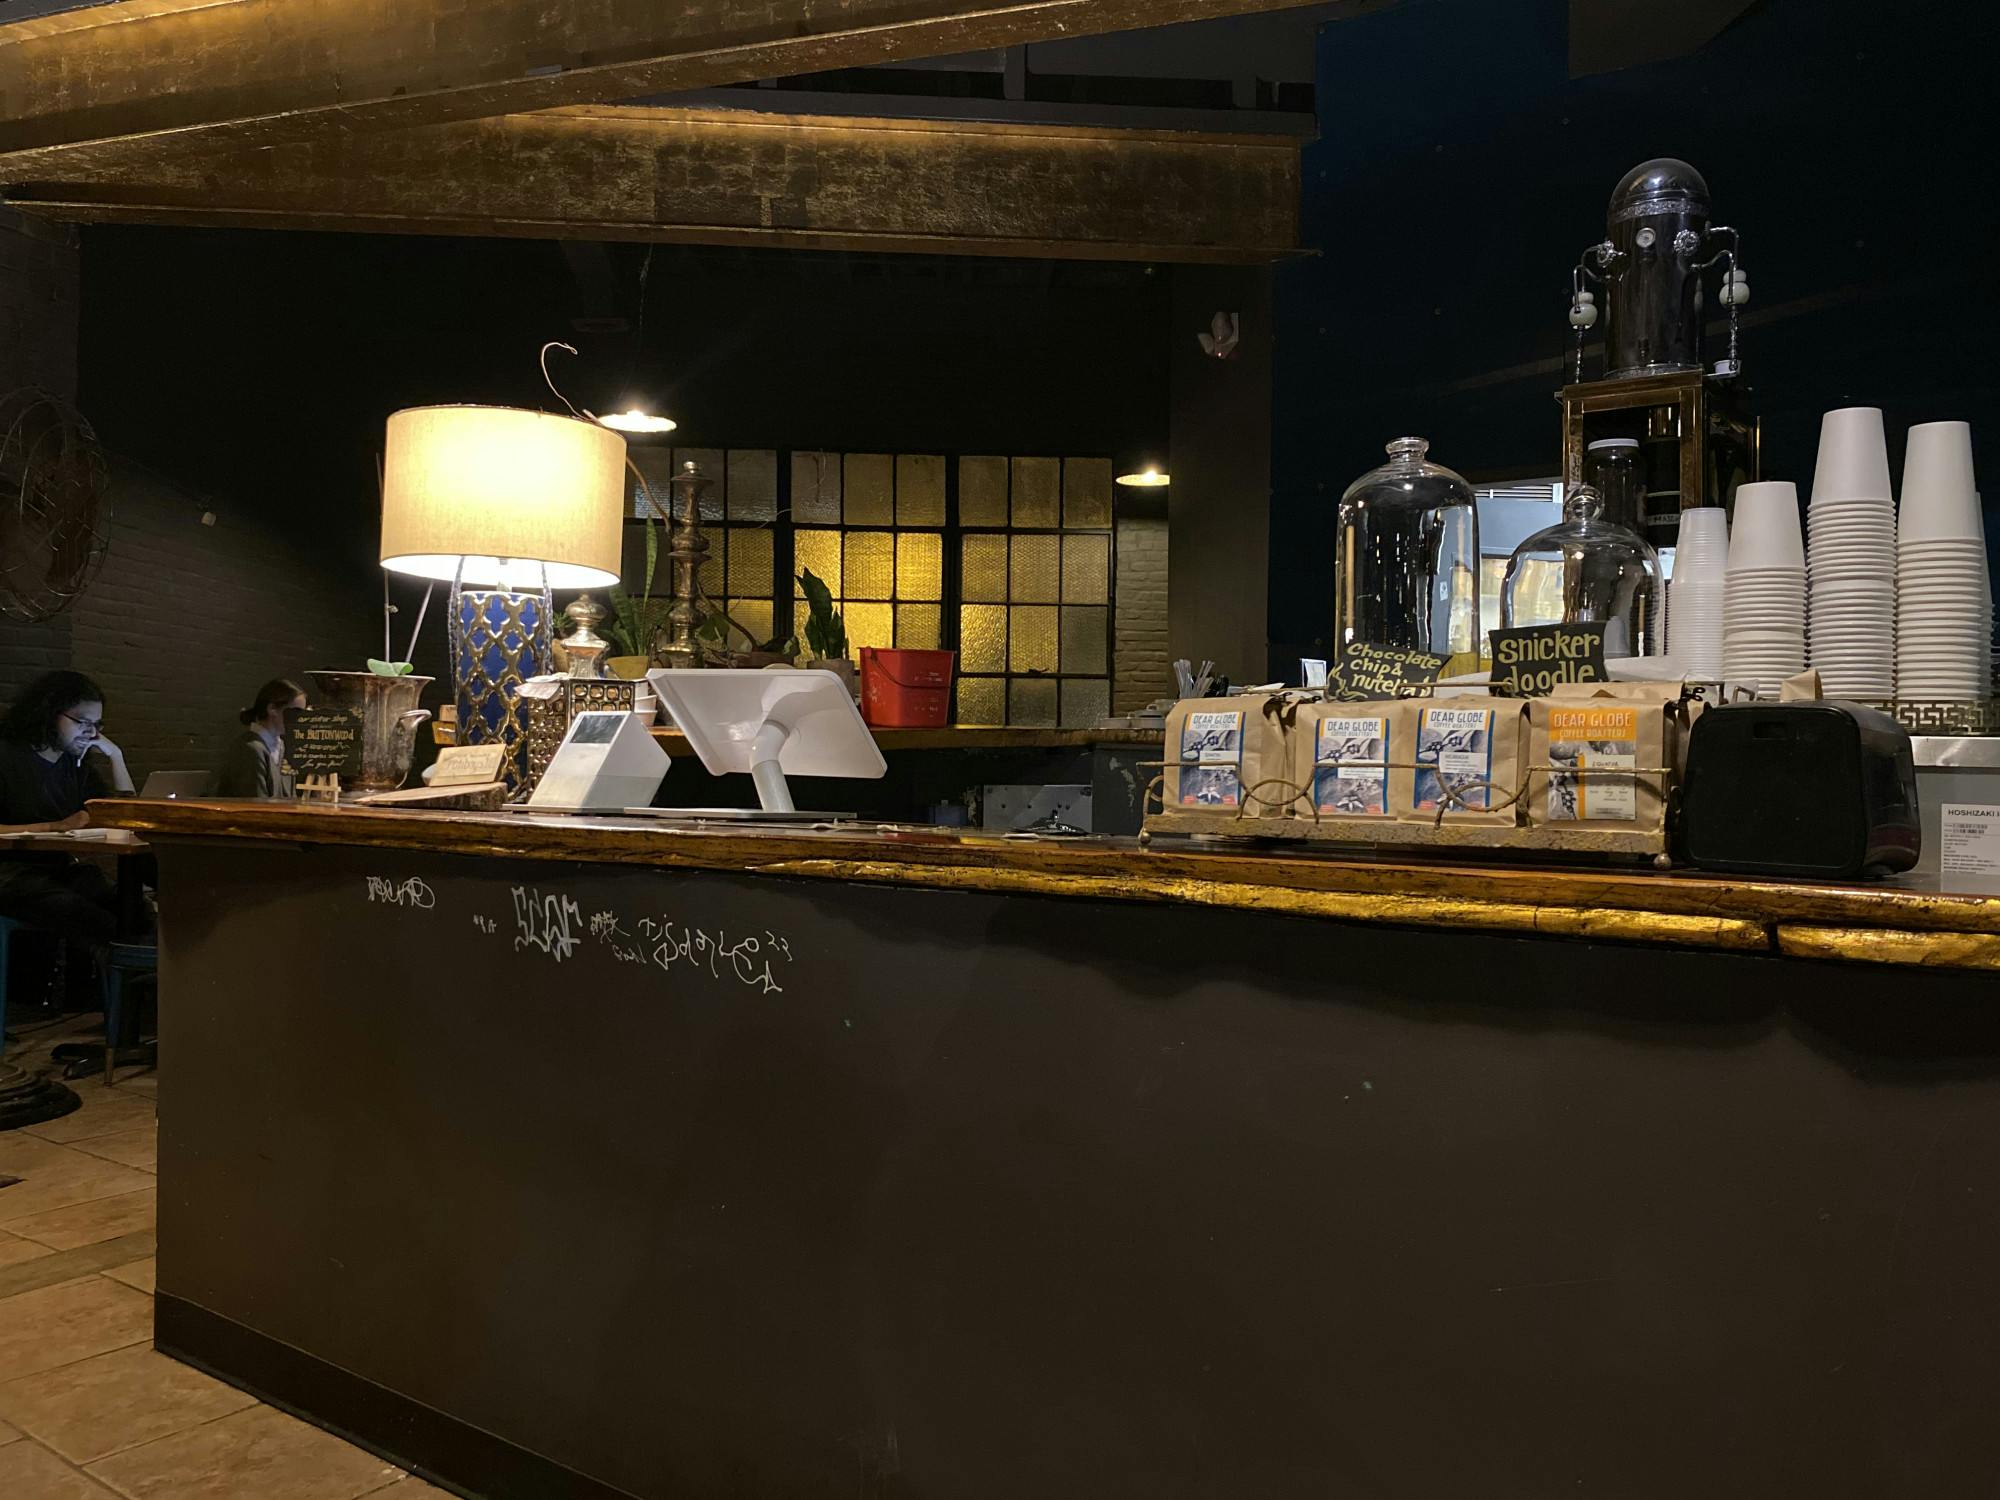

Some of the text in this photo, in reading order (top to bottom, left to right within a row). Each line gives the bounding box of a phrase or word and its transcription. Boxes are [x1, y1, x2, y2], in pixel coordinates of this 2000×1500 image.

[1346, 642, 1442, 670] Chocolate
[1502, 661, 1595, 693] doodle
[1193, 714, 1236, 724] DEAR GLOBE
[1430, 711, 1483, 723] DEAR GLOBE
[1554, 712, 1633, 727] DEAR GLOBE
[1327, 721, 1379, 731] DEAR GLOBE
[1560, 729, 1585, 737] COFFEE
[1948, 809, 1995, 817] HOSHIZAKI
